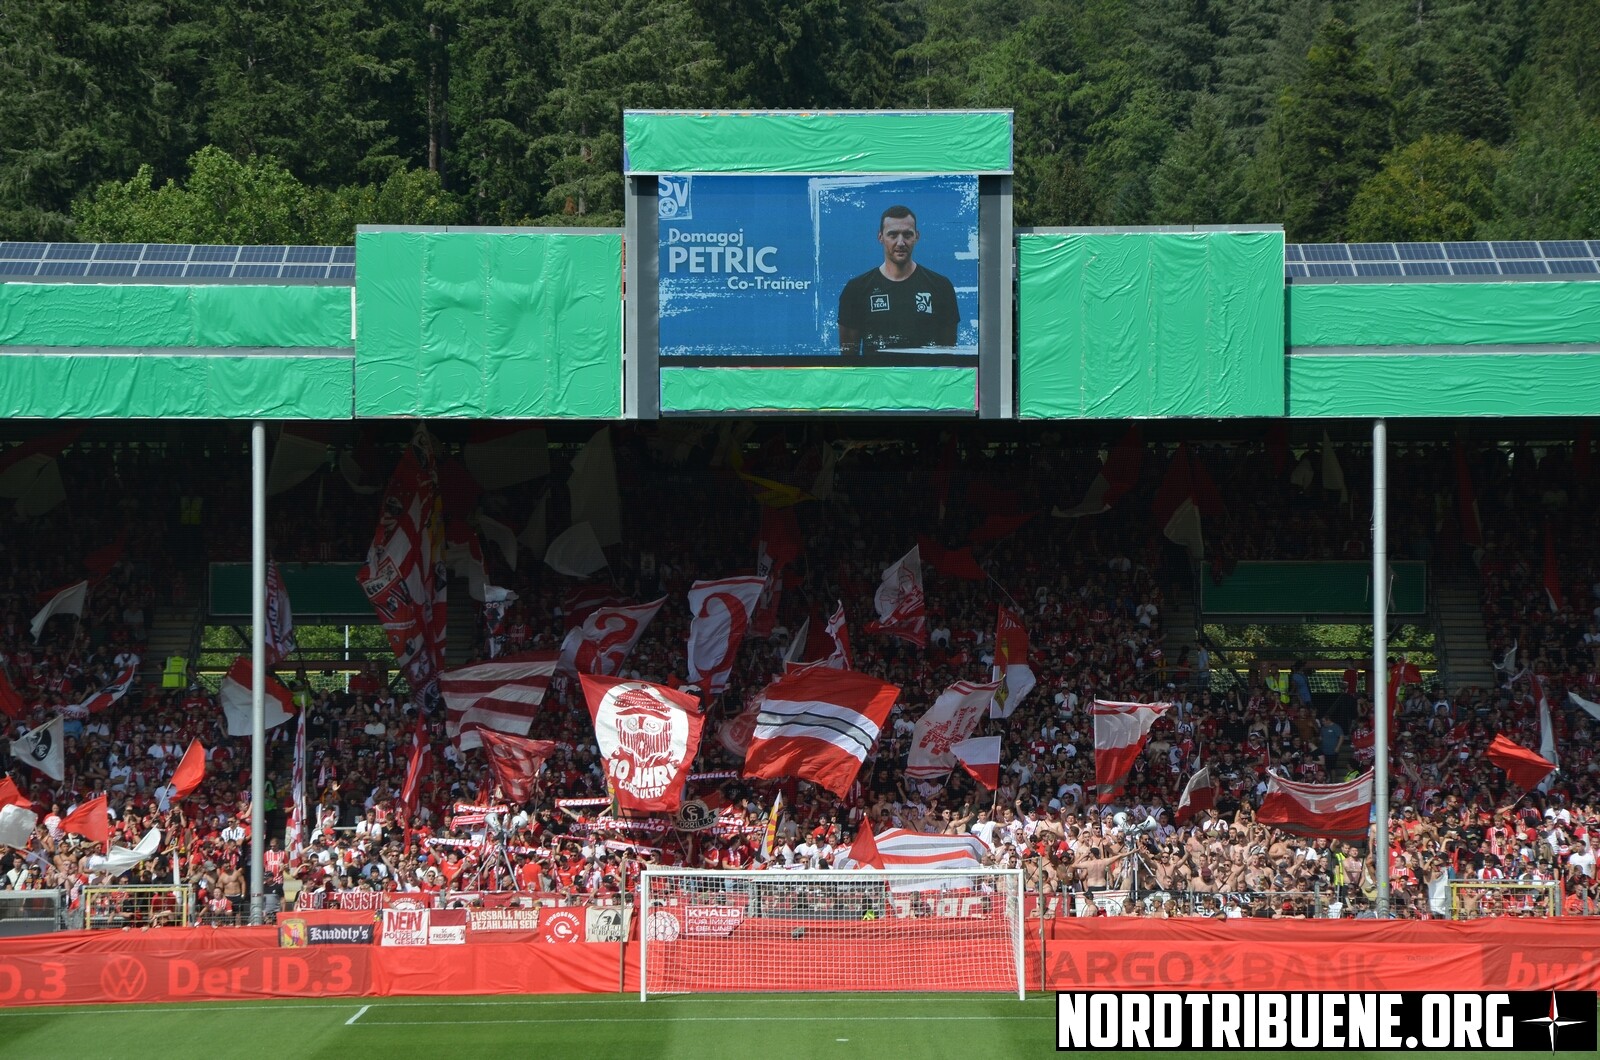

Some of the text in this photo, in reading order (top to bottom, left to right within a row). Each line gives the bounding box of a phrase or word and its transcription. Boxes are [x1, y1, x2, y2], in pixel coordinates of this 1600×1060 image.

[668, 228, 744, 247] Domagoj
[668, 246, 778, 273] PETRIC
[727, 276, 812, 290] Co-Trainer
[608, 758, 630, 780] 10
[471, 910, 539, 922] FUSSBALL MUSS
[689, 909, 740, 917] KHALID
[387, 911, 423, 932] NEIN
[471, 919, 538, 931] BEZAHLBAR SEIN
[310, 927, 369, 942] Knaddly's
[394, 937, 426, 945] GESETZ
[168, 955, 353, 996] Der ID.3
